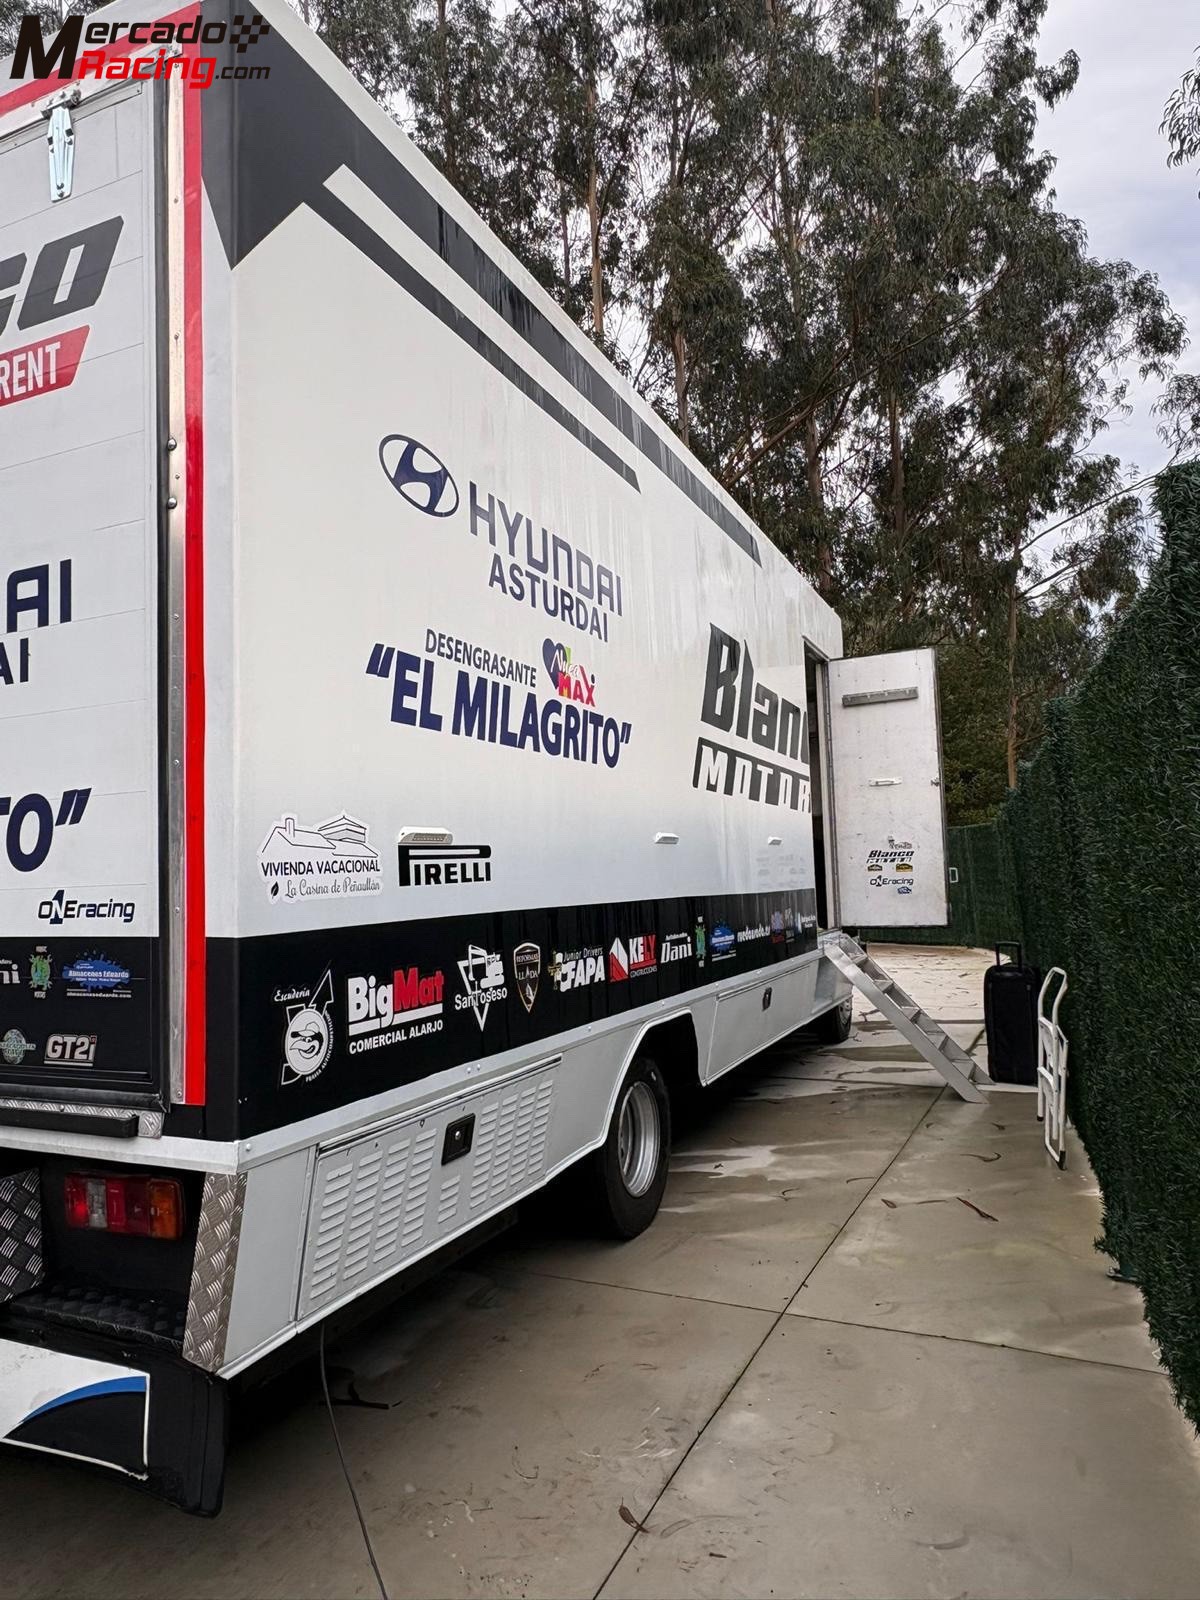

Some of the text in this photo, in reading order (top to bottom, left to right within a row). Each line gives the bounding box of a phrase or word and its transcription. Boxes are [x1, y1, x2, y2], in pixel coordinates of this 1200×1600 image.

[469, 480, 624, 617] HYUNDAI
[488, 553, 609, 643] ASTURDAI
[425, 629, 537, 688] DESENGRASANTE
[261, 859, 380, 877] VIVIENDA VACACIONAL
[398, 844, 492, 887] PIRELLI
[868, 850, 915, 858] Blanco
[284, 880, 297, 899] La
[299, 879, 328, 897] Casina
[330, 878, 341, 894] de
[563, 947, 603, 962] Junior Drivers
[628, 934, 656, 964] KELY
[660, 936, 693, 963] Dani
[347, 967, 445, 1028] BigMat
[47, 1034, 97, 1061] GT2i
[349, 1019, 444, 1055] COMERCIAL ALARJO
